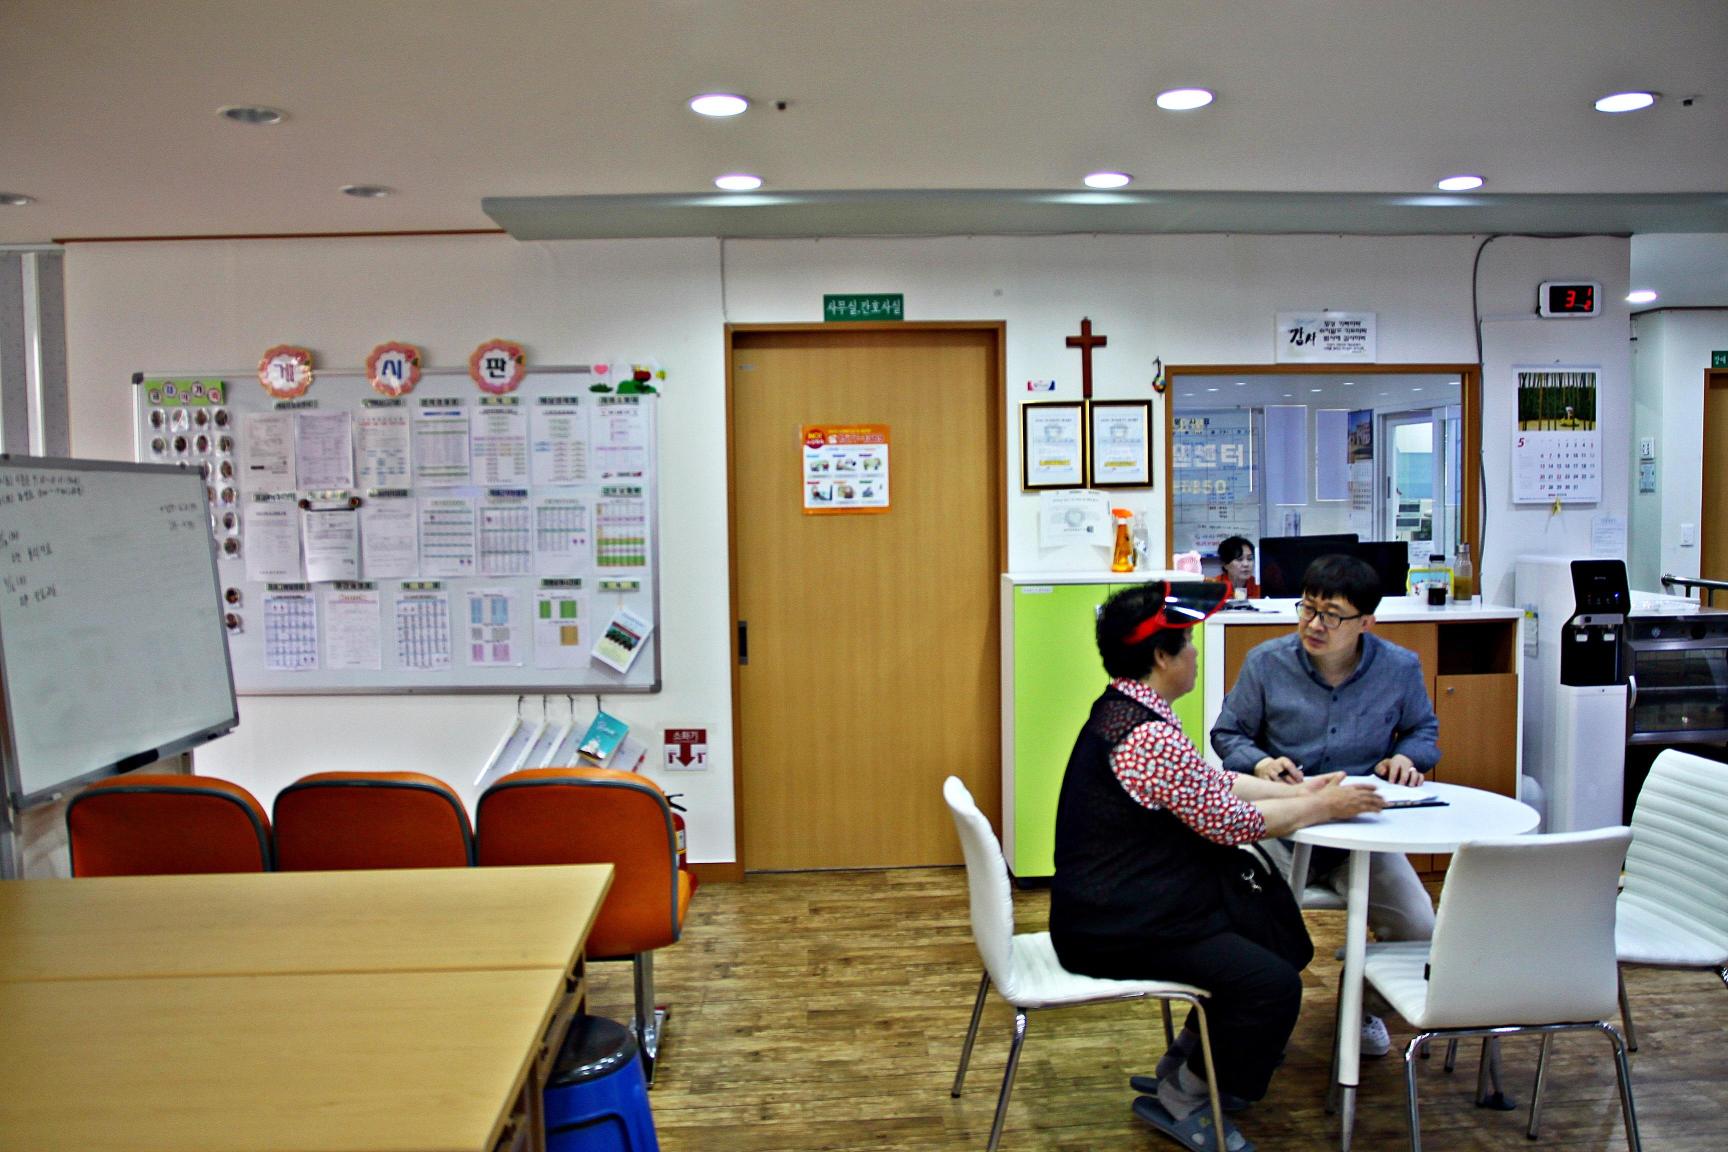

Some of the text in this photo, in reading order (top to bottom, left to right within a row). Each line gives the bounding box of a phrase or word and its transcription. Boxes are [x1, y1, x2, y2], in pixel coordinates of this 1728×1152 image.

[1564, 290, 1576, 308] 3
[1289, 326, 1316, 346] 감사
[381, 359, 402, 380] 시
[486, 357, 507, 378] 판
[1518, 437, 1525, 448] 5
